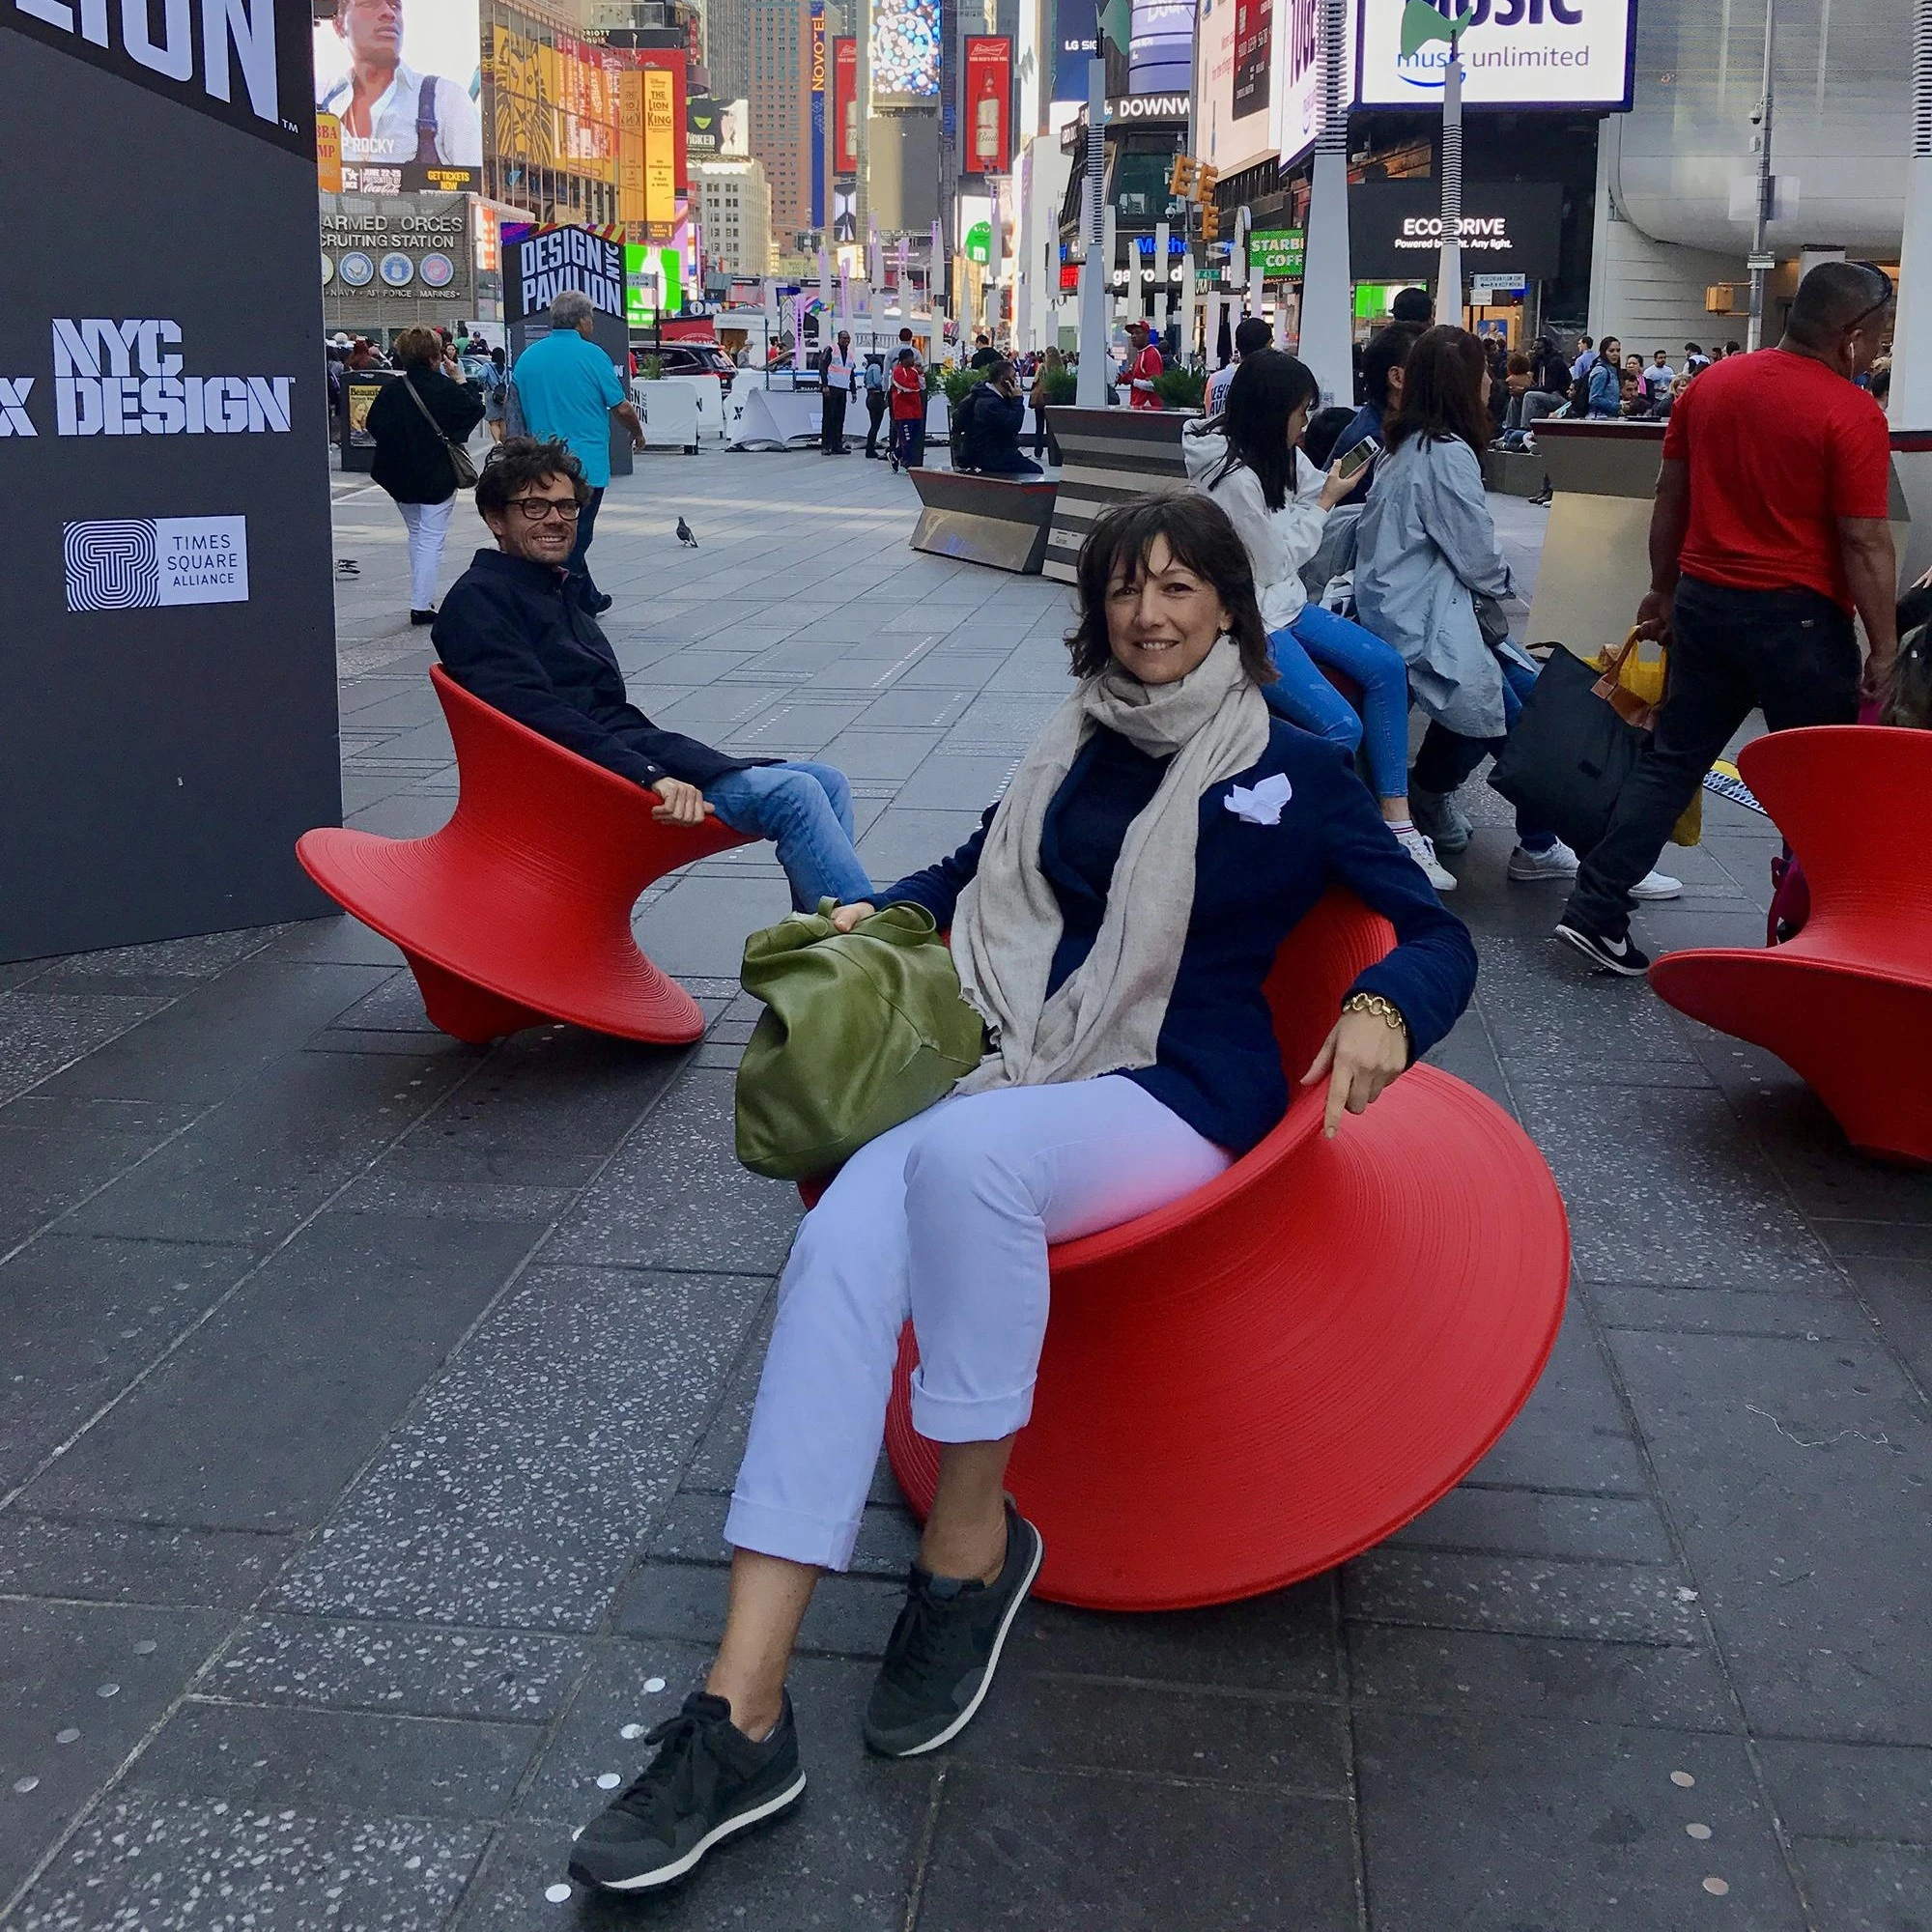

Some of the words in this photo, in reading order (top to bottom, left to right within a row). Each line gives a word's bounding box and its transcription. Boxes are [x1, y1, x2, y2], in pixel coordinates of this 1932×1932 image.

[1406, 0, 1582, 26] USIC
[811, 11, 825, 91] NOVOTEL
[1065, 41, 1079, 50] LG
[1472, 45, 1589, 68] unlimited
[650, 91, 666, 99] THE
[648, 99, 668, 111] LION
[647, 112, 671, 127] KING
[428, 170, 440, 181] GET
[441, 171, 470, 182] TICKETS
[440, 182, 458, 190] NOW
[322, 215, 387, 232] ARMED
[391, 236, 454, 248] STATION
[1251, 238, 1304, 252] STARB
[1394, 239, 1434, 249] Powered
[1470, 239, 1489, 250] Any
[522, 228, 602, 278] DESIGN
[605, 242, 620, 280] NYC
[52, 318, 184, 378] NYC
[55, 376, 292, 436] DESIGN
[172, 534, 231, 551] TIMES
[167, 553, 238, 572] SQUARE
[173, 573, 235, 586] ALLIANCE
